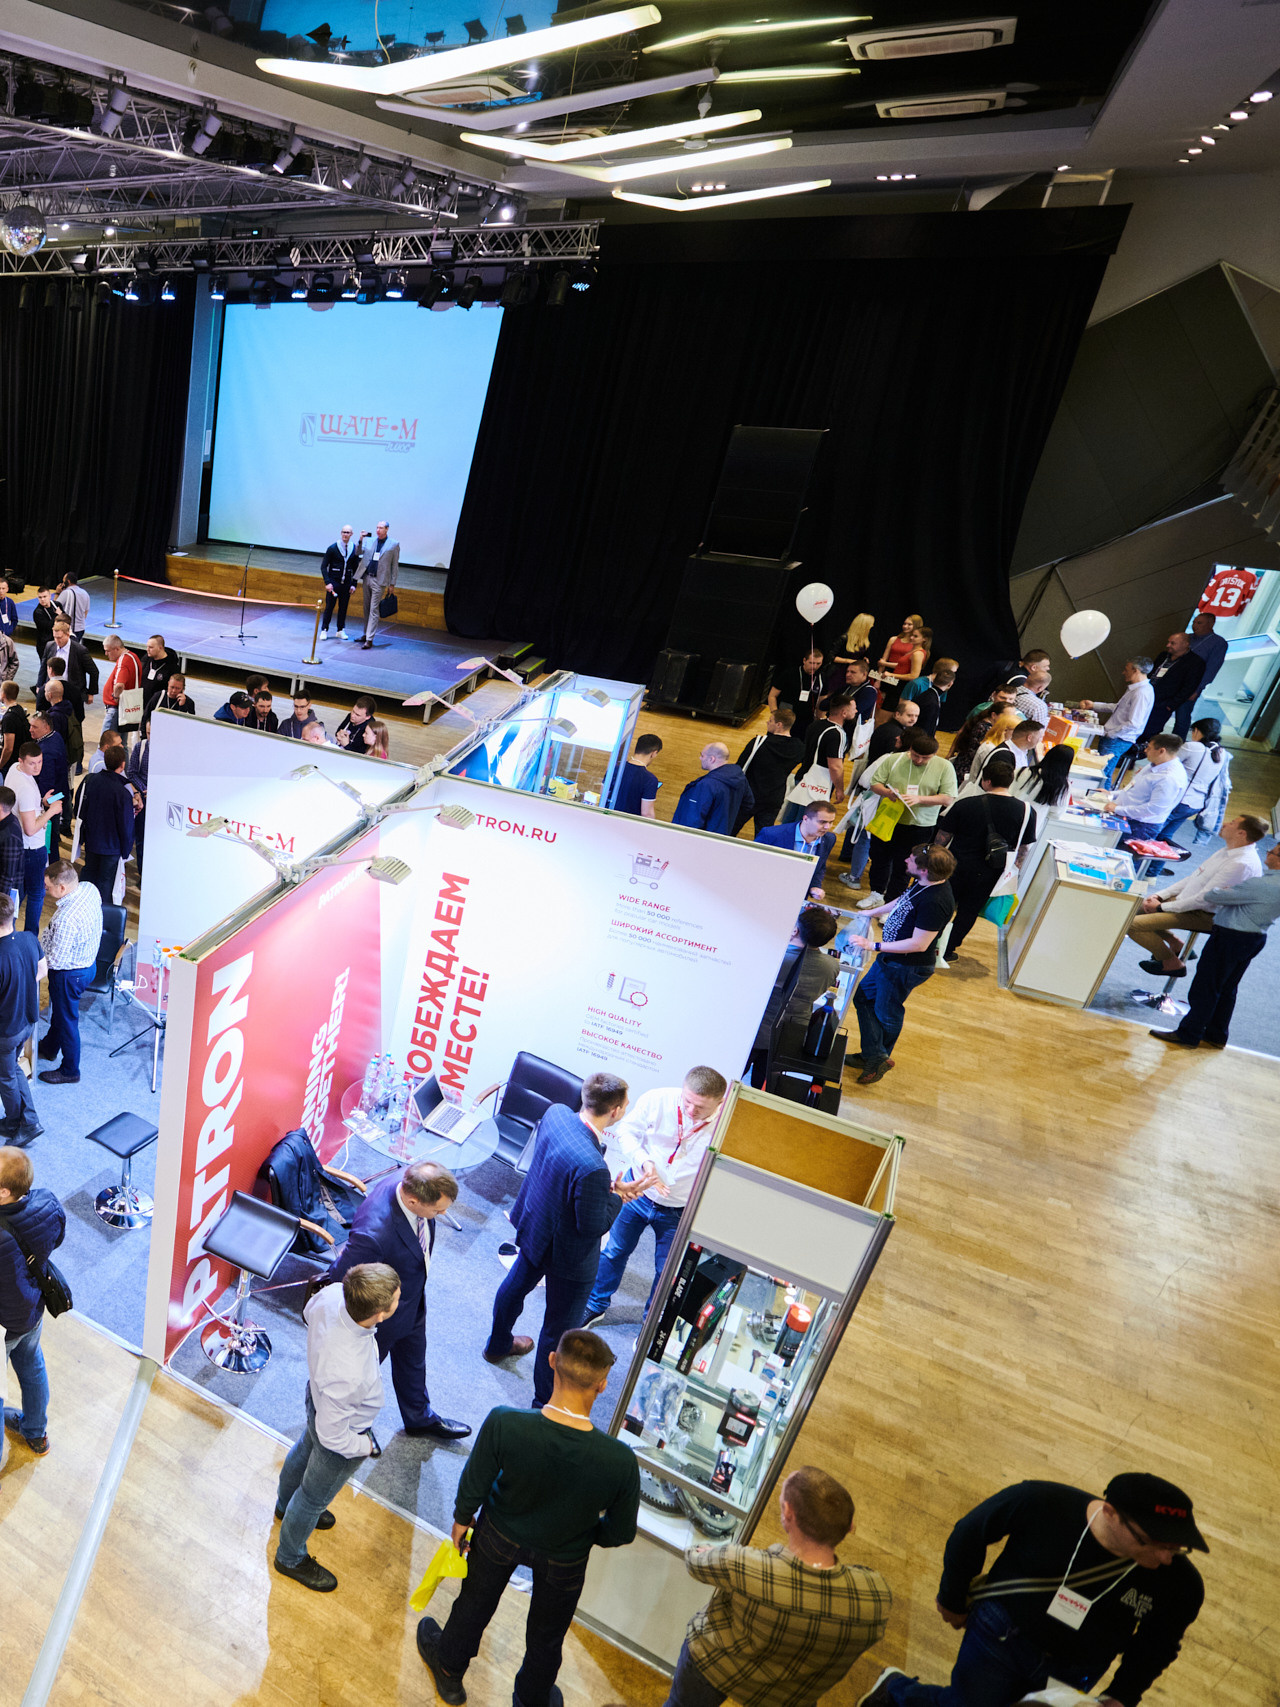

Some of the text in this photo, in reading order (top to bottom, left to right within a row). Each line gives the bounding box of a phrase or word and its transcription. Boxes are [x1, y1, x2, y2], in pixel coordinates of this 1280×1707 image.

[1210, 587, 1241, 608] 13
[475, 812, 557, 844] TRON.RU
[619, 893, 671, 913] WIDE RANGE
[656, 912, 671, 921] 000
[611, 919, 718, 953] ШИРОКИЙ АССОРТИМЕНТ
[638, 935, 652, 944] 000
[438, 966, 490, 1096] МЕСТЕ!
[587, 1006, 642, 1028] HIGH QUALITY
[581, 1028, 663, 1061] ВЫСОКОЕ КАЧЕСТВО
[312, 966, 351, 1158] OGETHER!
[300, 1022, 329, 1137] NNING
[180, 950, 255, 1330] PATRON
[674, 1277, 687, 1298] BLADE
